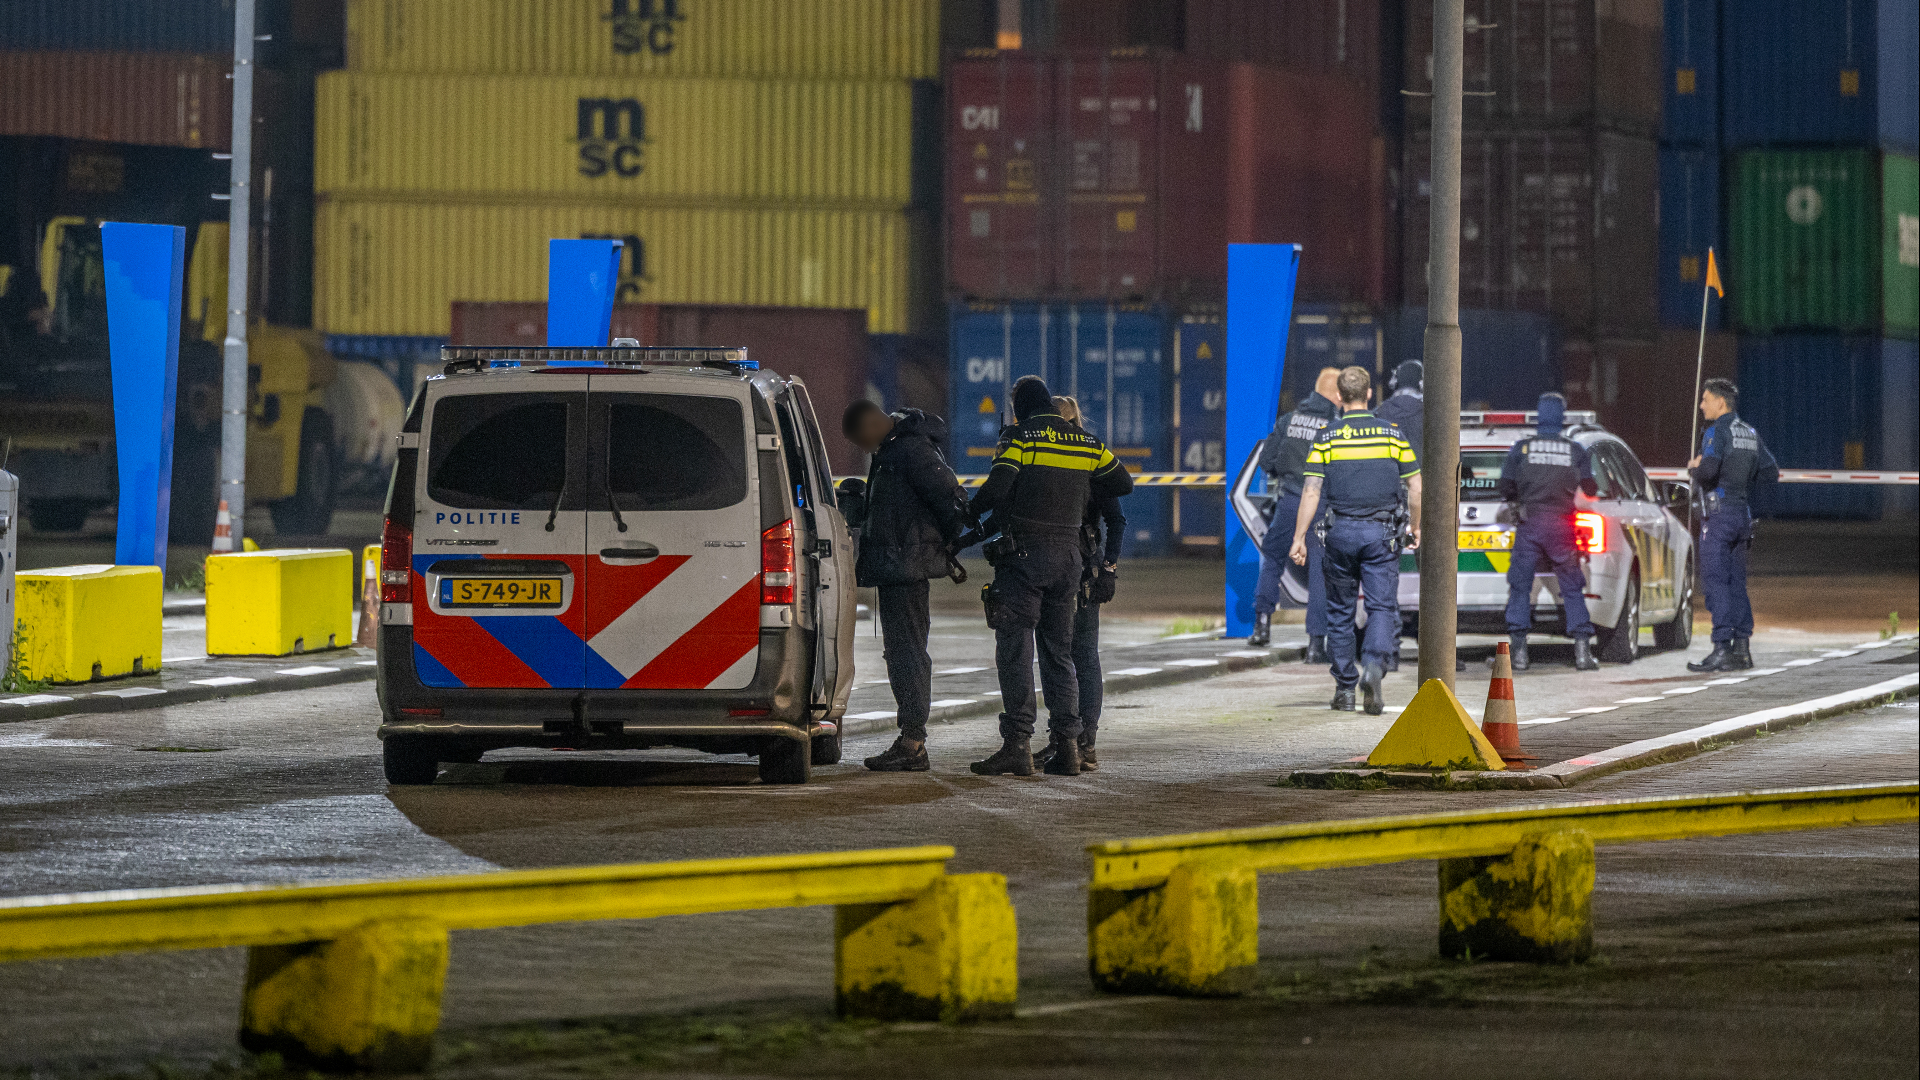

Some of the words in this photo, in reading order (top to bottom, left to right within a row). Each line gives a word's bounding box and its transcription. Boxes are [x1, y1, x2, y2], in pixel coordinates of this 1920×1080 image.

[1185, 441, 1223, 472] 45
[436, 512, 520, 525] POLITIE
[461, 582, 551, 600] S-749-JR
